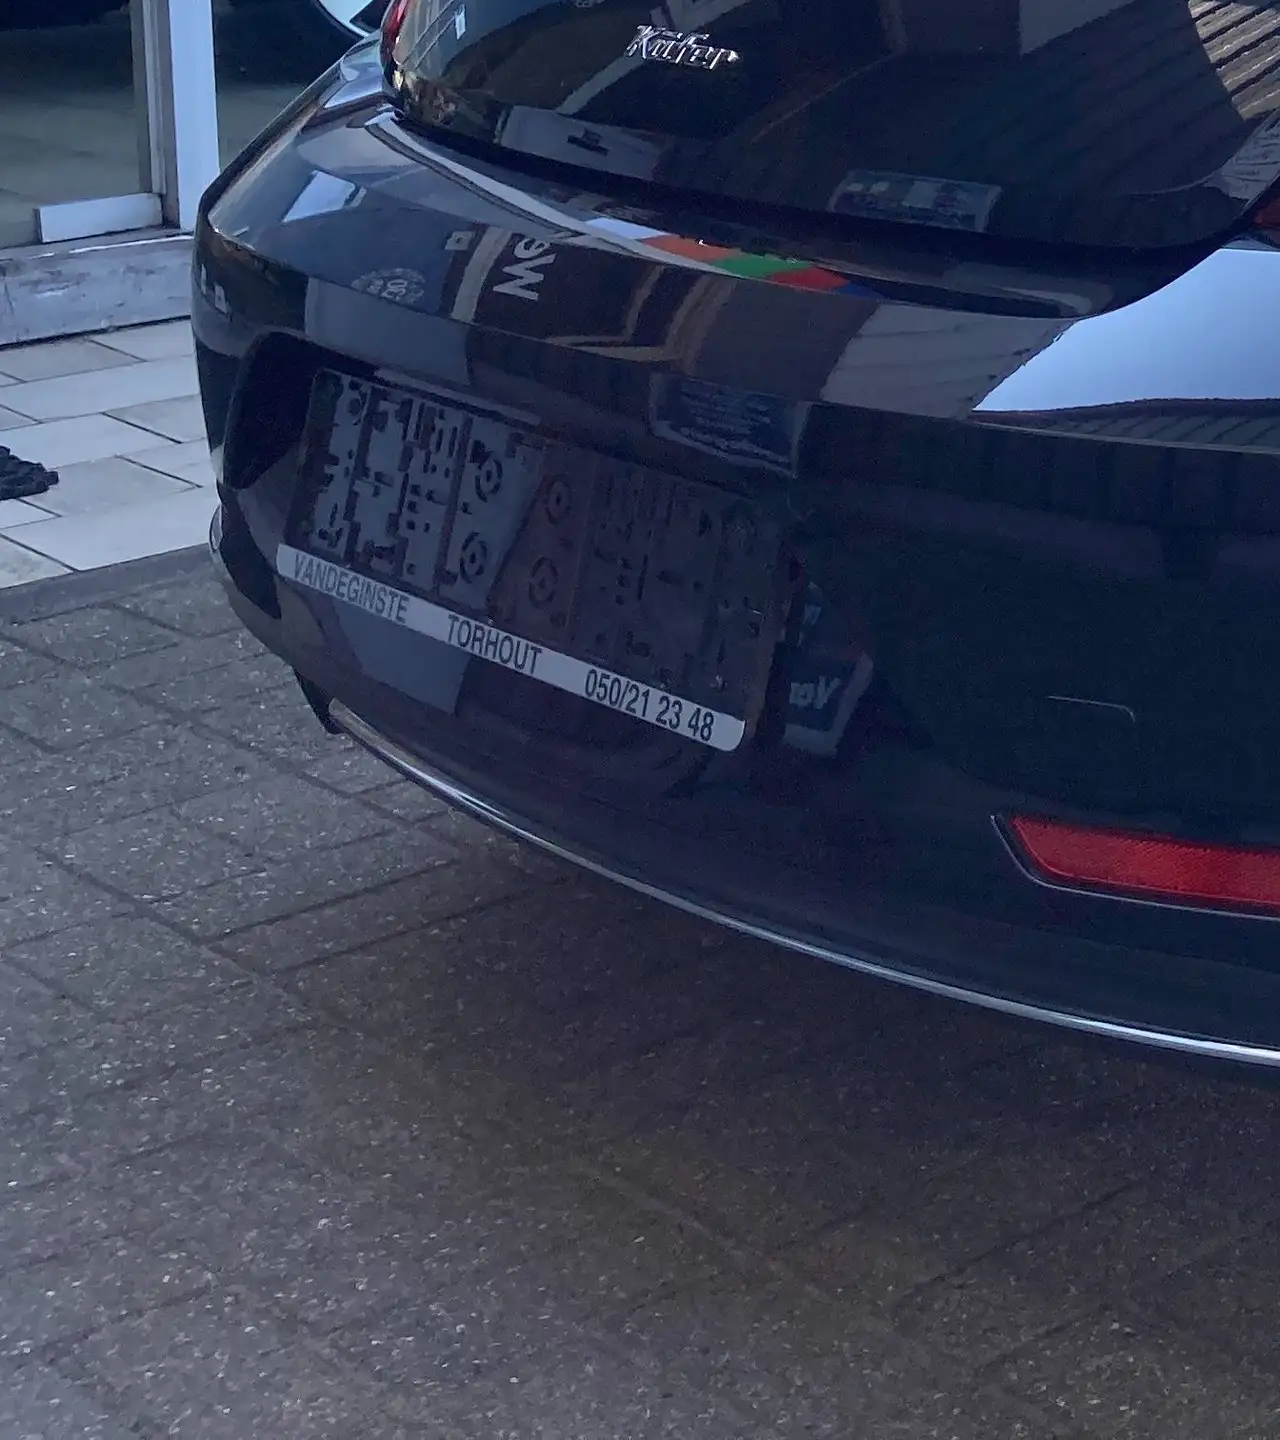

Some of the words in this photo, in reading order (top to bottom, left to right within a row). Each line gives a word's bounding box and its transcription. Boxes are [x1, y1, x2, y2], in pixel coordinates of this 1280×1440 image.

[293, 551, 412, 628] VANDEGINSTE
[446, 613, 544, 676] TORHOUT
[584, 668, 651, 719] 050/21
[655, 698, 684, 733] 23
[686, 707, 715, 743] 48
